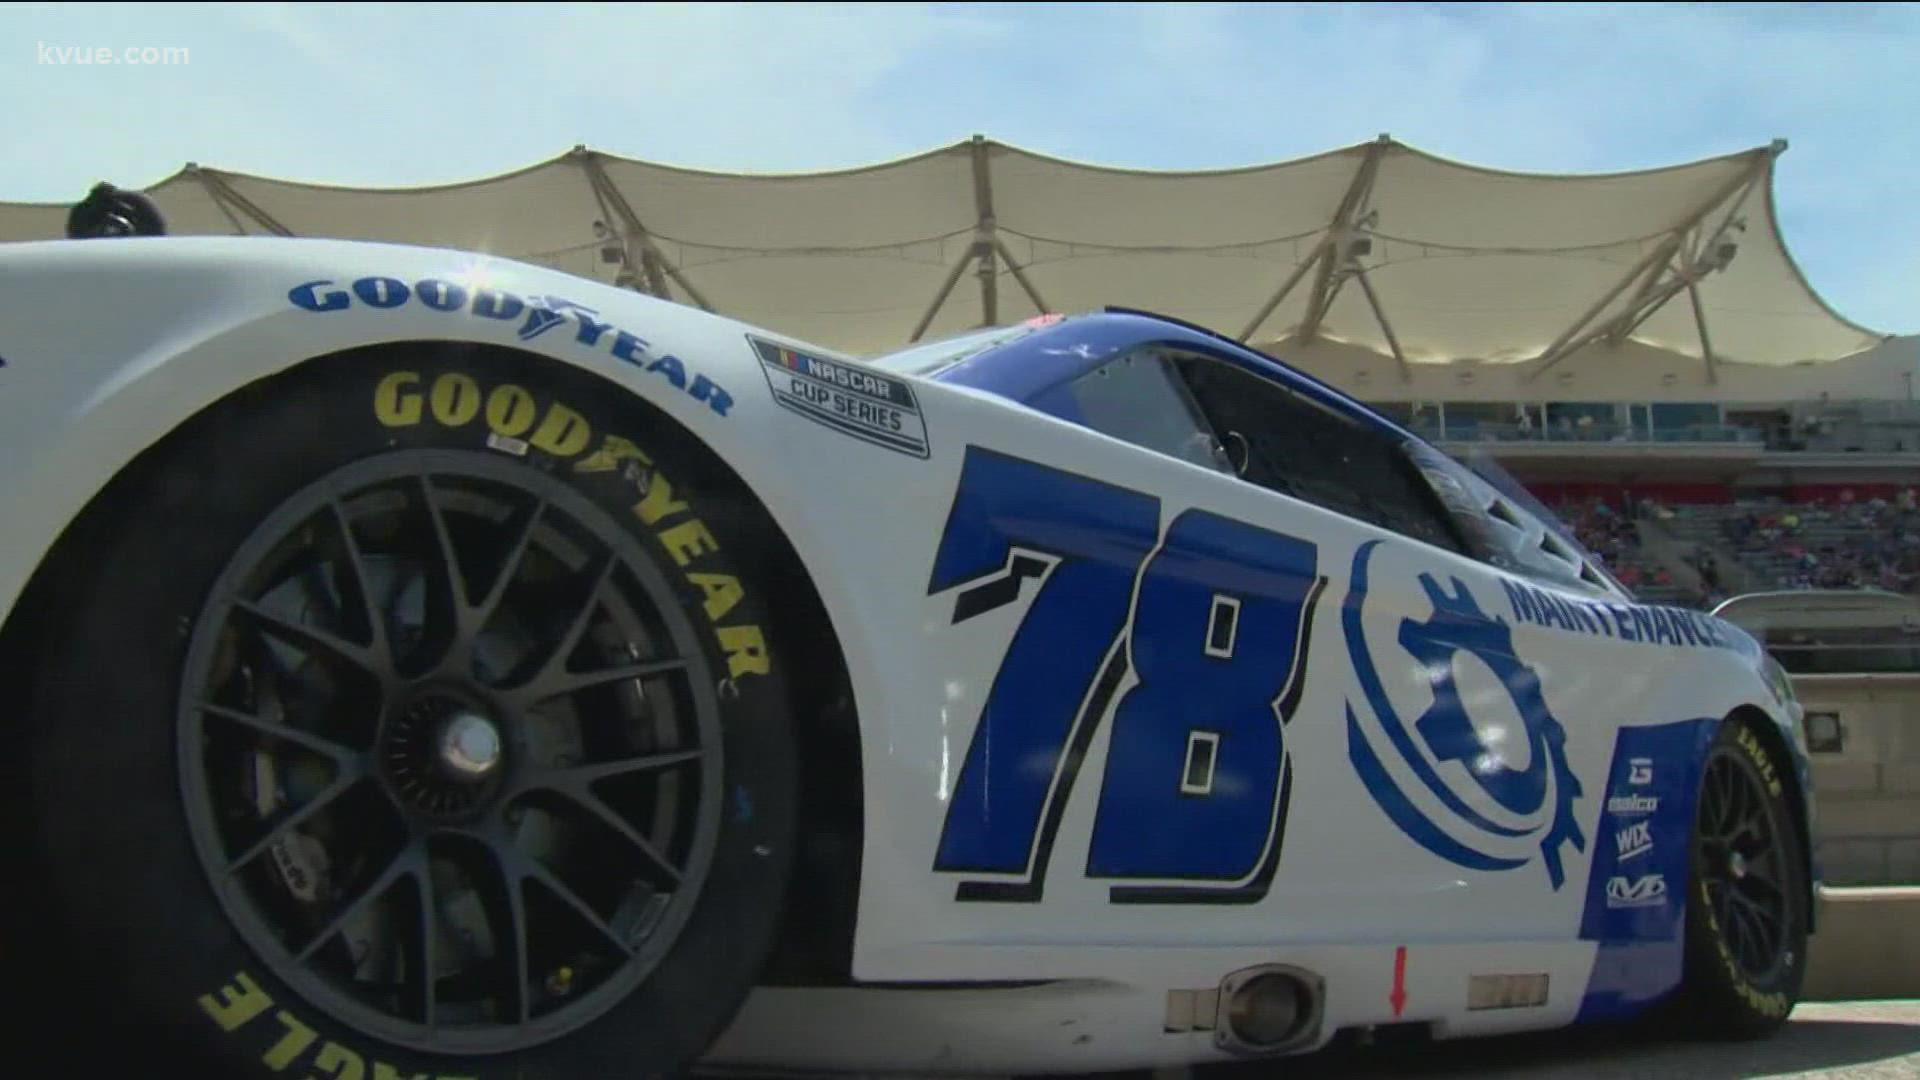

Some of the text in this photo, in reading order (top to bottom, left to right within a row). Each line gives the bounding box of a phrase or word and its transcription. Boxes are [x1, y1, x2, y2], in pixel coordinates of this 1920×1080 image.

[289, 277, 733, 417] GOODYEAR
[807, 358, 890, 398] NASCAR
[791, 379, 901, 431] CUP SERIES
[375, 371, 770, 677] GOODYEAR
[1501, 577, 1730, 647] MAINTENANCE
[928, 445, 1328, 904] 78
[1616, 821, 1651, 854] WIX
